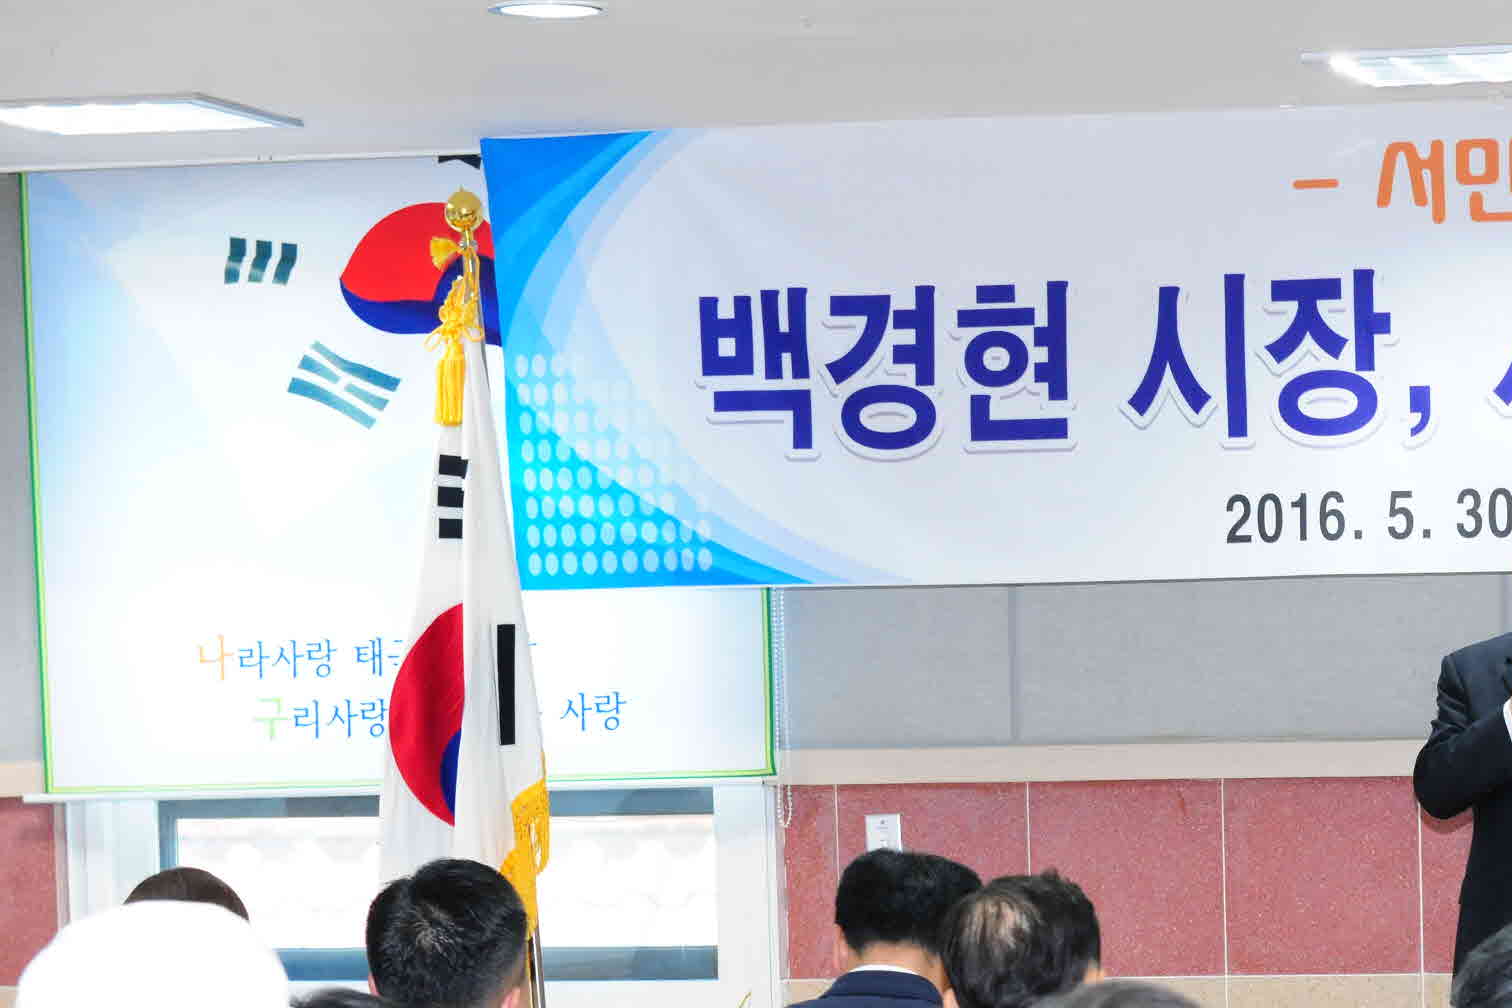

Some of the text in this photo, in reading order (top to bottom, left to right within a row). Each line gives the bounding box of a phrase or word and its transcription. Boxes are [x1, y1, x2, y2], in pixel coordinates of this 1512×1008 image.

[698, 280, 1069, 450] 백경현
[1128, 268, 1431, 438] 시장,
[1226, 491, 1362, 544] 2016.
[1388, 490, 1431, 540] 5.
[199, 635, 337, 681] 나라사랑
[254, 690, 627, 741] 구리사랑 사랑
